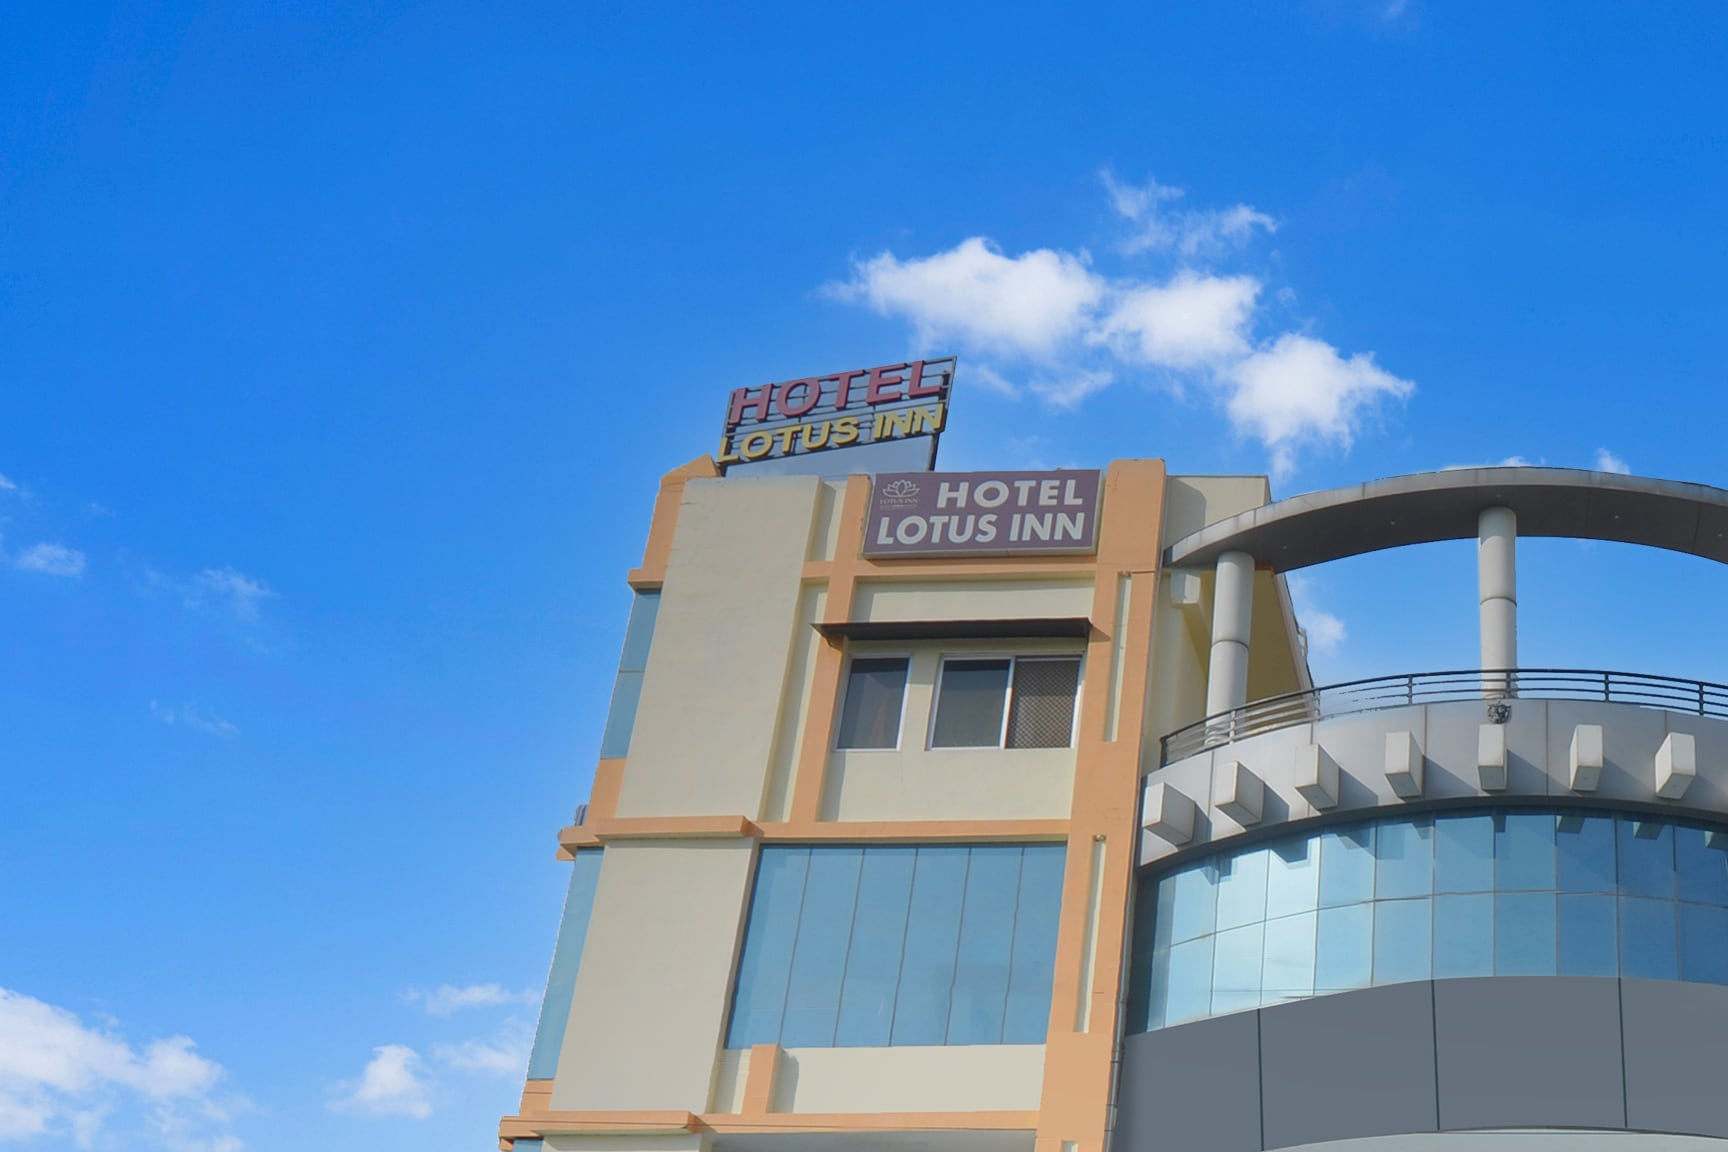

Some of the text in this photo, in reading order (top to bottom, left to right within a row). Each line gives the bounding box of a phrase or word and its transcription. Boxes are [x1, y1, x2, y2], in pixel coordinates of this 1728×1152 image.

[728, 360, 942, 424] HOTEL
[717, 402, 946, 464] LOTUS INN
[936, 479, 1084, 509] HOTEL
[876, 511, 1085, 545] LOTUS INN
